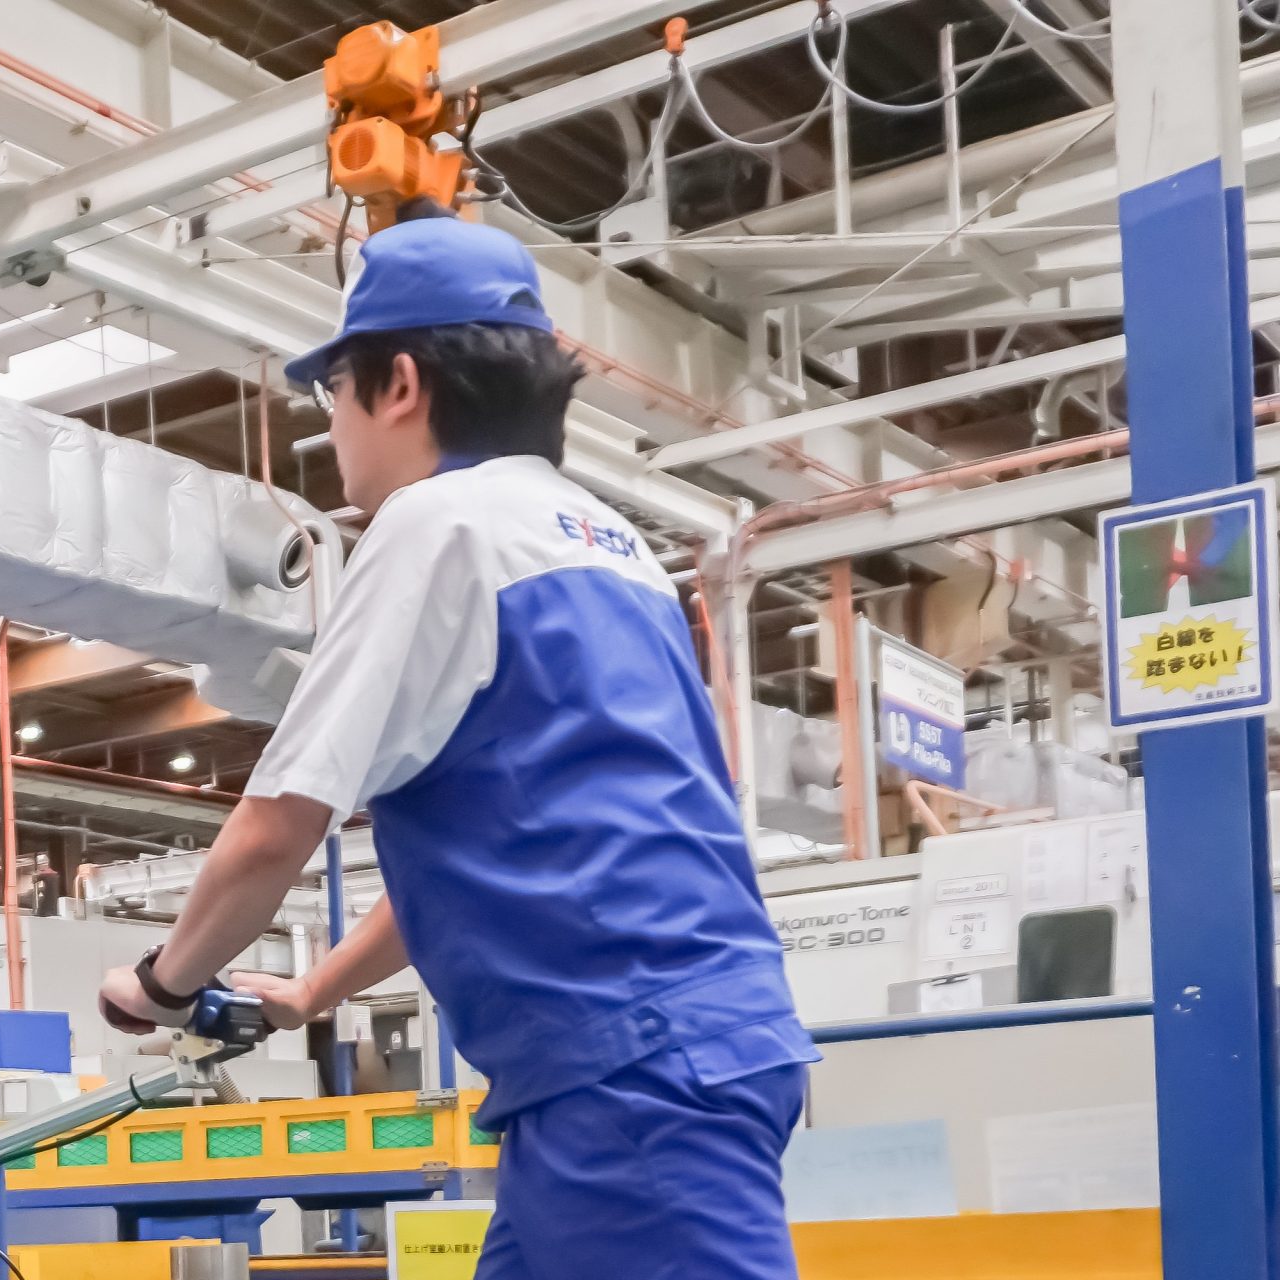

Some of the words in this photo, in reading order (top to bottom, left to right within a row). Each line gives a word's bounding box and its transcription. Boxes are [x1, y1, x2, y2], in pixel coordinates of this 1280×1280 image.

[556, 511, 640, 560] EXEDY
[1156, 627, 1215, 652] 白線を
[773, 906, 910, 933] akamura-Tome
